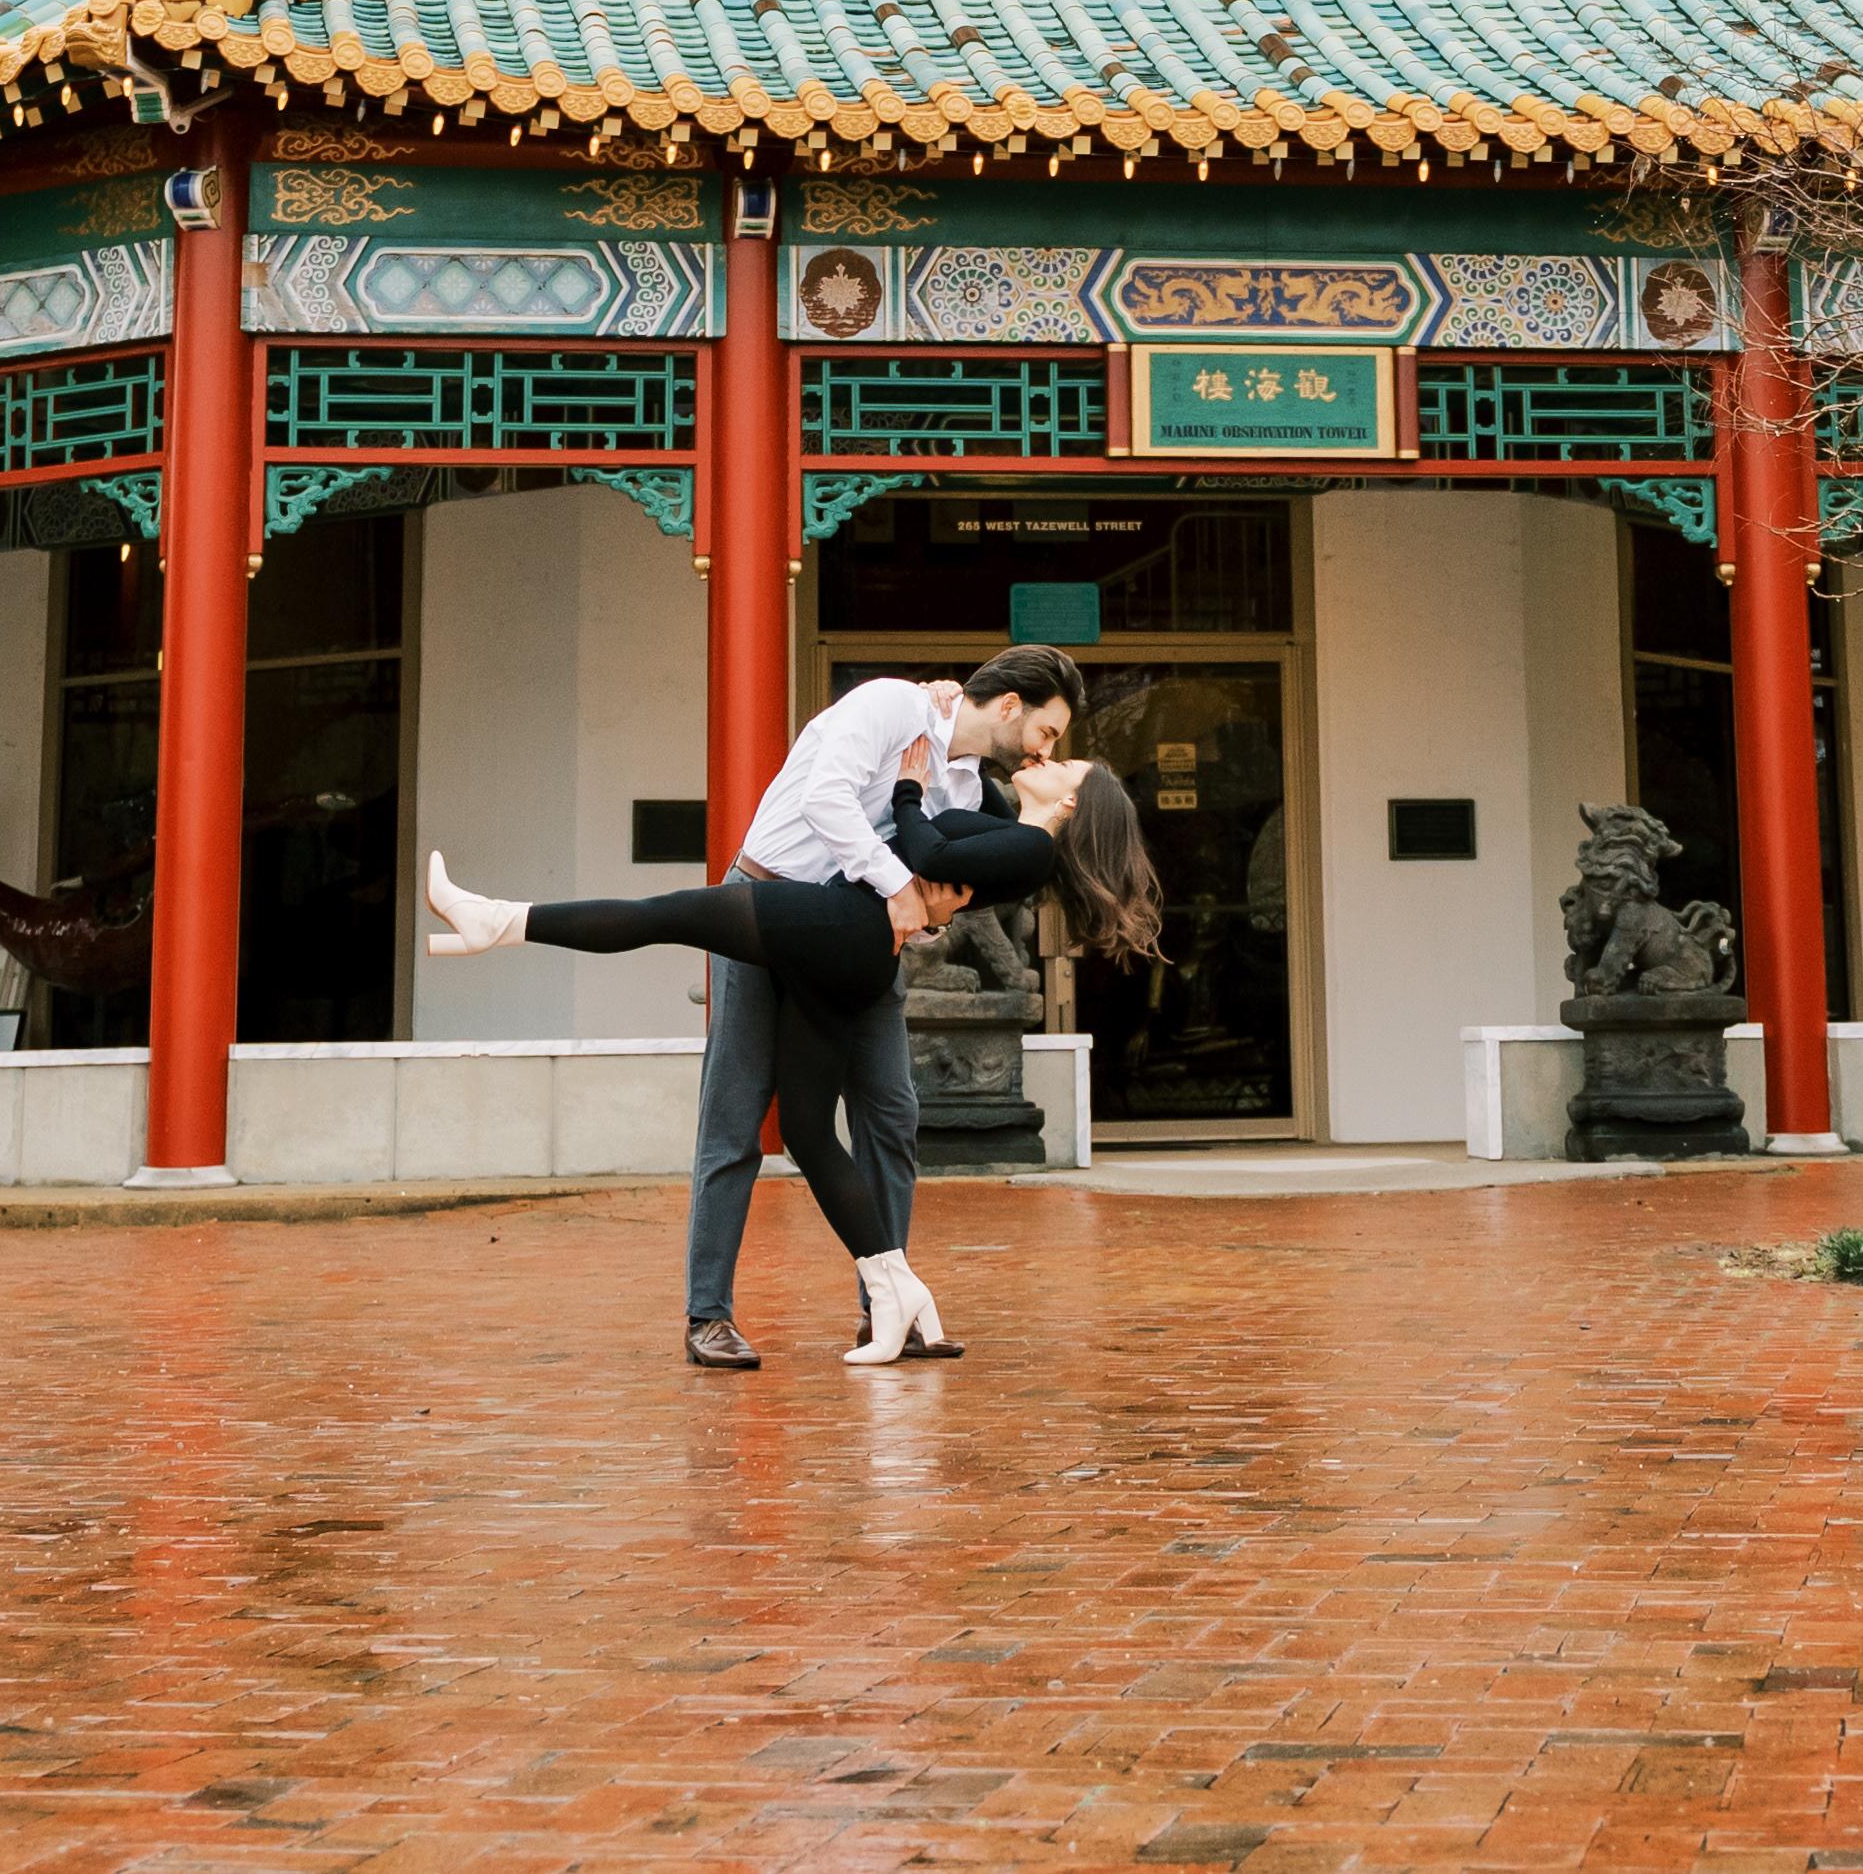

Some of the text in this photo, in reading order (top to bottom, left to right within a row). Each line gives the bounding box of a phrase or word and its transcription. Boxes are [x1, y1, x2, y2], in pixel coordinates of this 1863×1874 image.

[1160, 424, 1368, 440] MARINE OBSERVATION TOWER
[985, 520, 1020, 531] WEST
[1025, 520, 1090, 531] TAZEWELL
[1095, 520, 1142, 531] STREET
